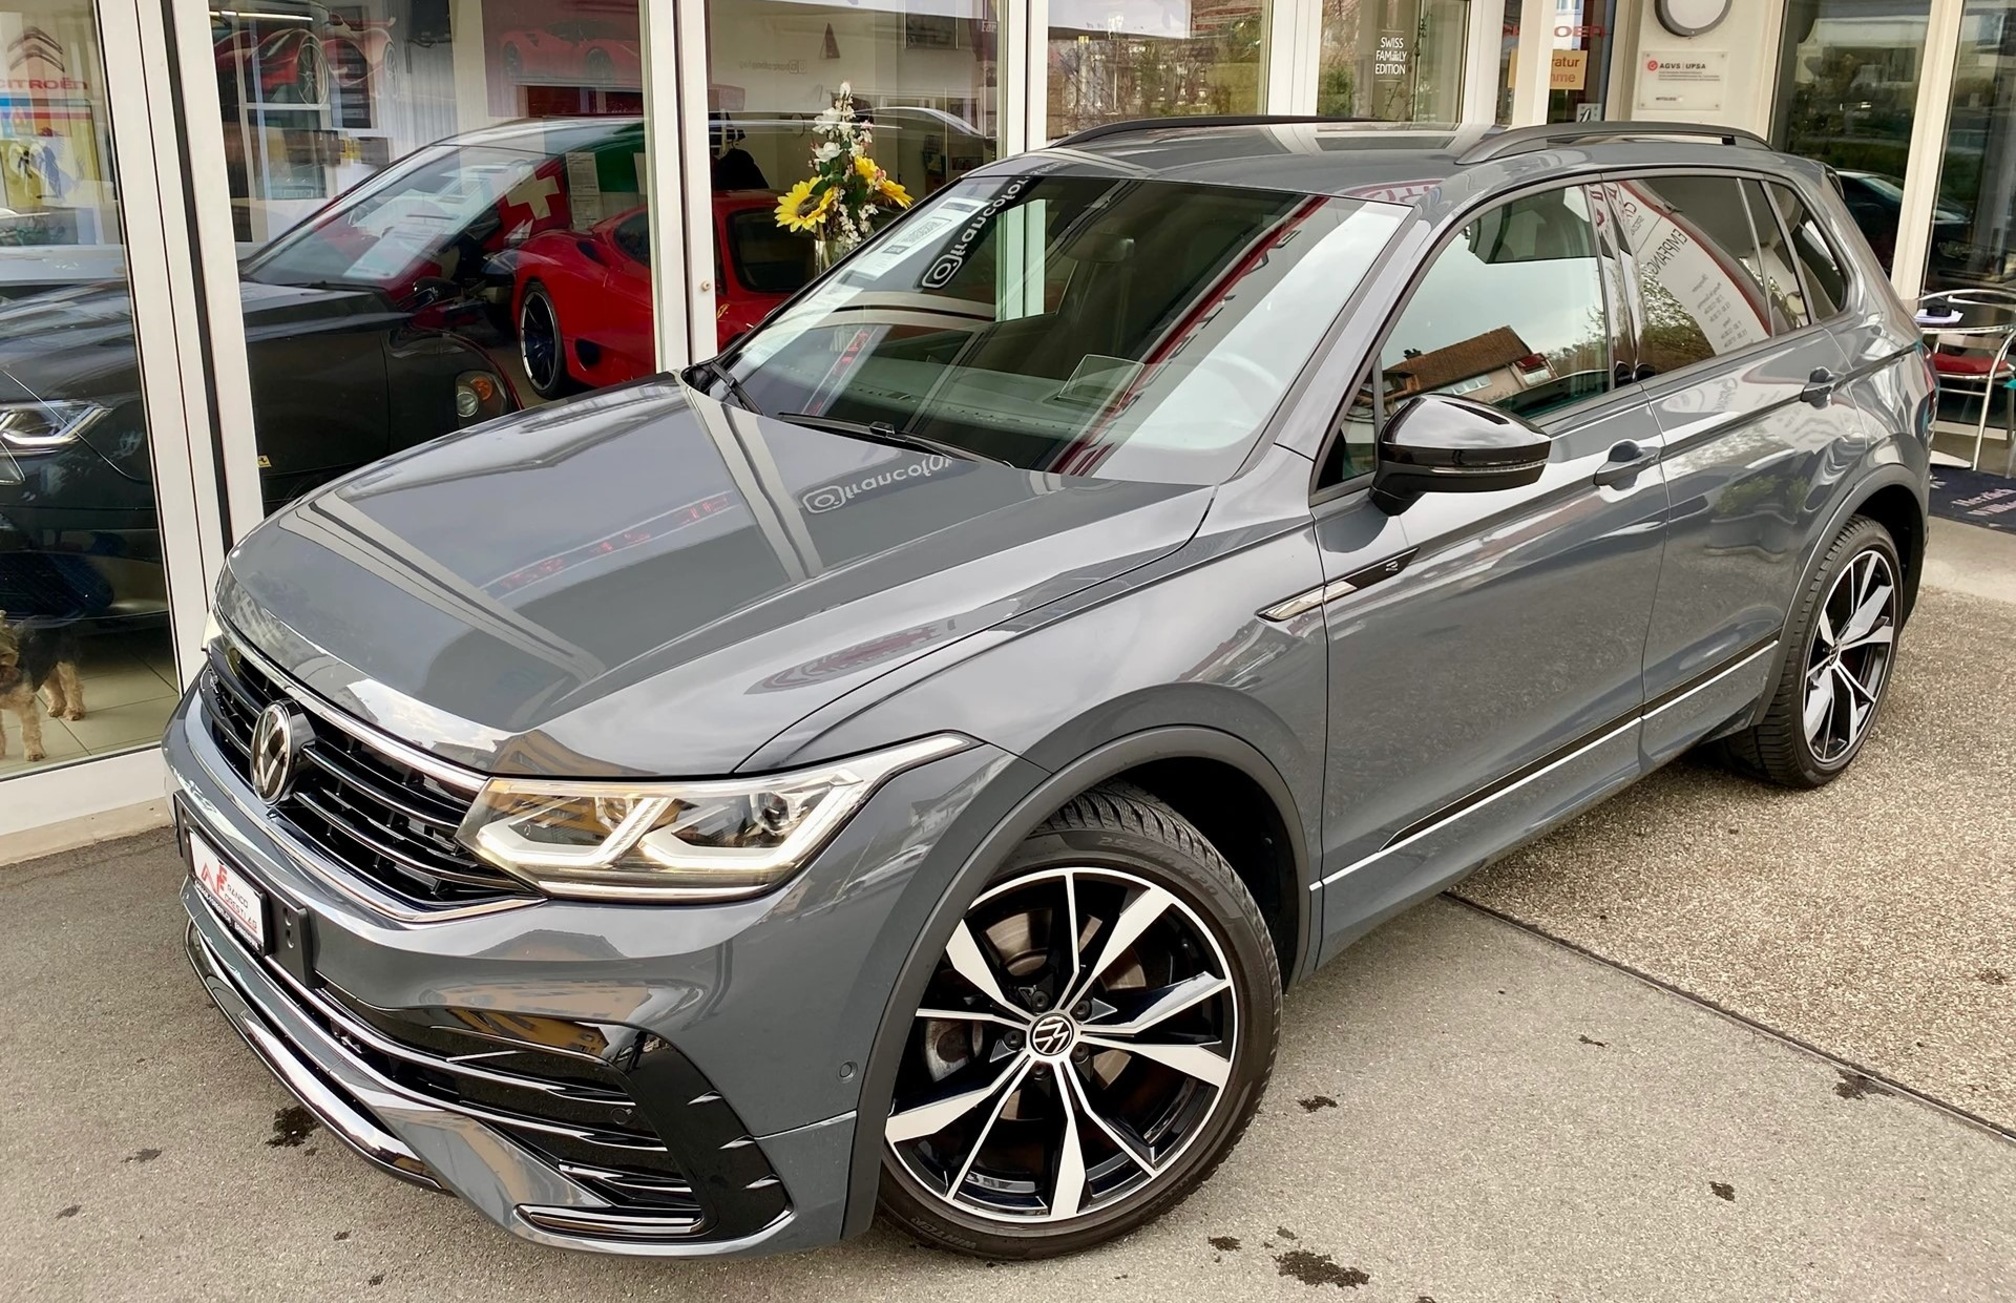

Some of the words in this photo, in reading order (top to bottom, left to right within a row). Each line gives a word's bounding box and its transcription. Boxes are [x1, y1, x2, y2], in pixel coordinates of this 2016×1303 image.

[1380, 37, 1404, 49] SWISS
[1552, 57, 1580, 68] ratur
[1375, 63, 1405, 75] EDITION
[911, 1216, 977, 1250] WINTER
